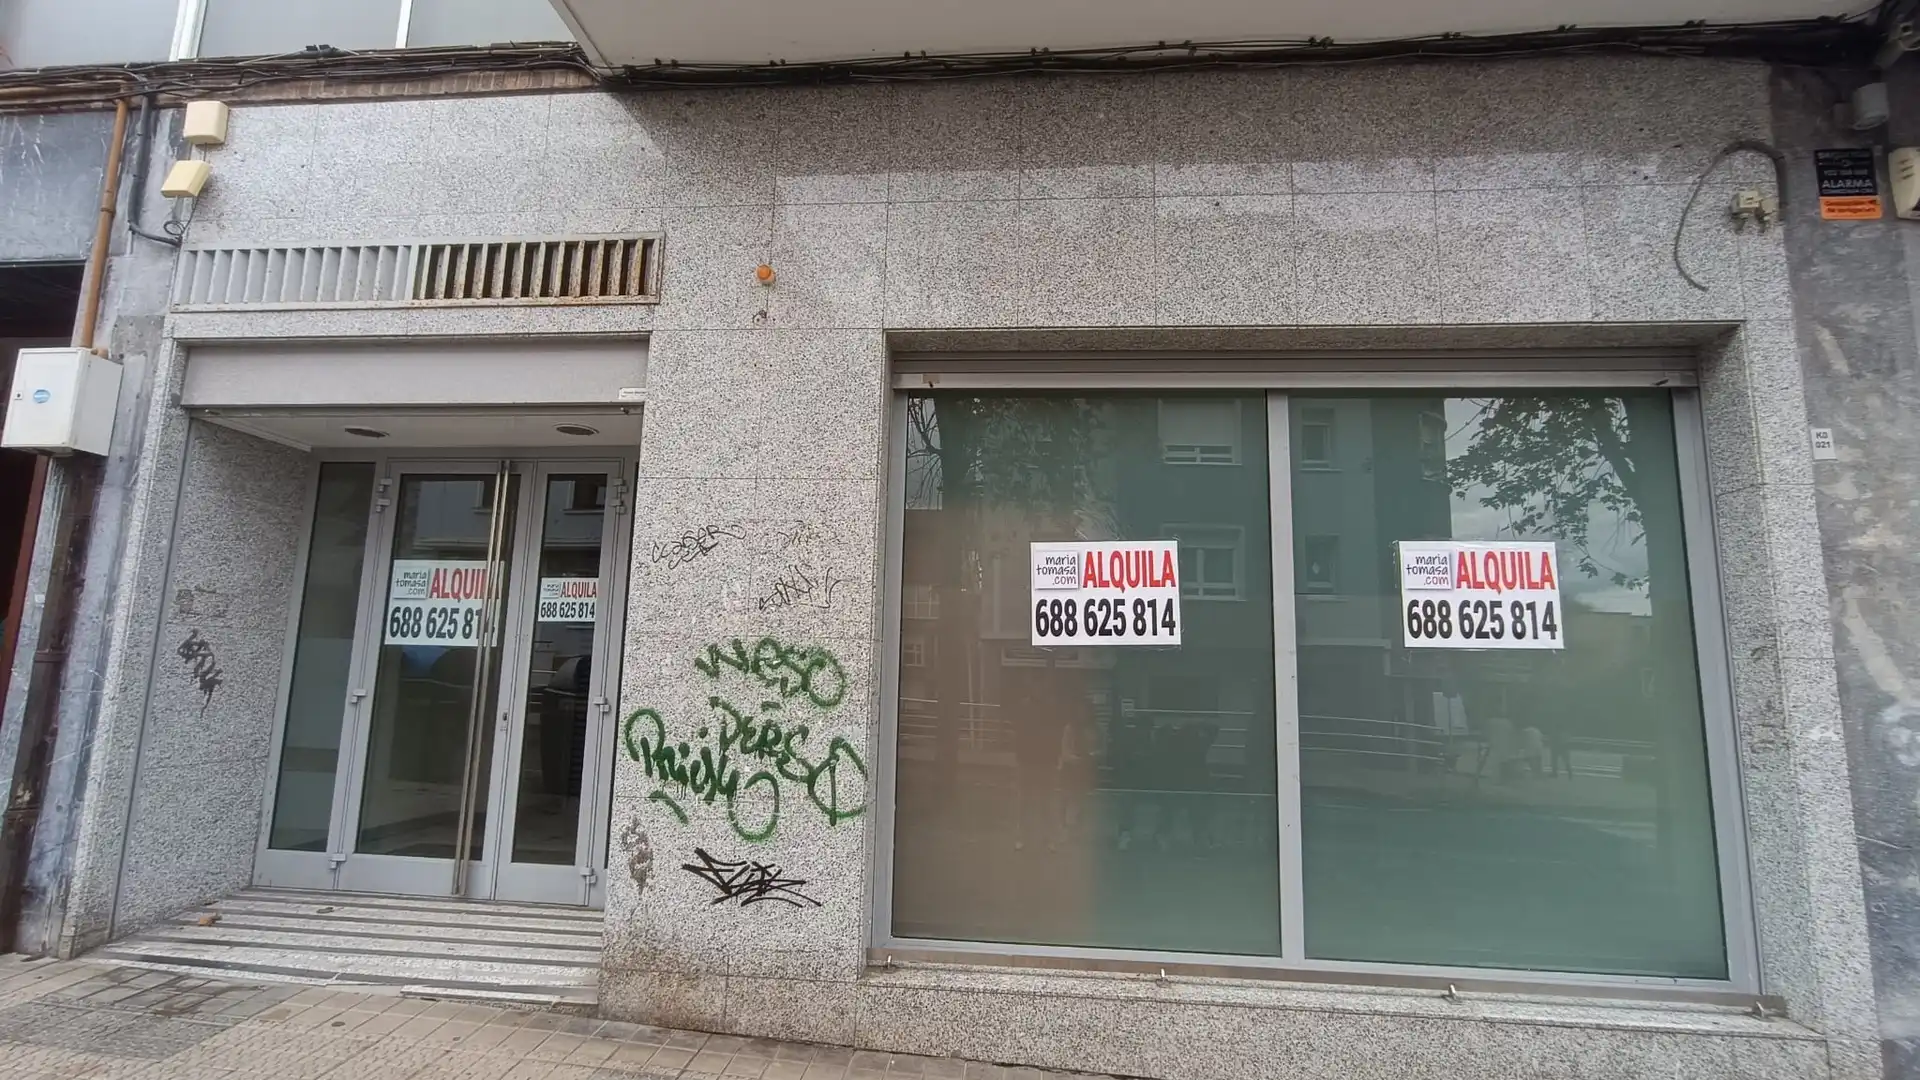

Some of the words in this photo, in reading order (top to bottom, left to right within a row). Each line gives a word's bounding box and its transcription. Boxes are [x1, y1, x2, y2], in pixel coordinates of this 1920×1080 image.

[1822, 179, 1873, 188] ALARMA
[1045, 554, 1077, 566] maria
[1415, 553, 1449, 565] maria
[403, 571, 427, 579] maria
[1035, 564, 1077, 576] tomasa
[1082, 550, 1177, 593] ALQUILA
[1405, 564, 1449, 576] tomasa
[1455, 550, 1556, 595] ALQUILA
[395, 577, 426, 588] tomasa
[560, 581, 597, 600] ALQUILA
[540, 601, 558, 618] 688
[559, 601, 577, 618] 625
[578, 601, 595, 618] 814
[389, 606, 424, 639] 688
[425, 606, 461, 640] 625
[1035, 598, 1078, 637] 688
[1083, 598, 1127, 637] 625
[1132, 597, 1176, 637] 814
[1407, 599, 1453, 639] 688
[1458, 599, 1505, 639] 625
[1510, 600, 1557, 640] 814
